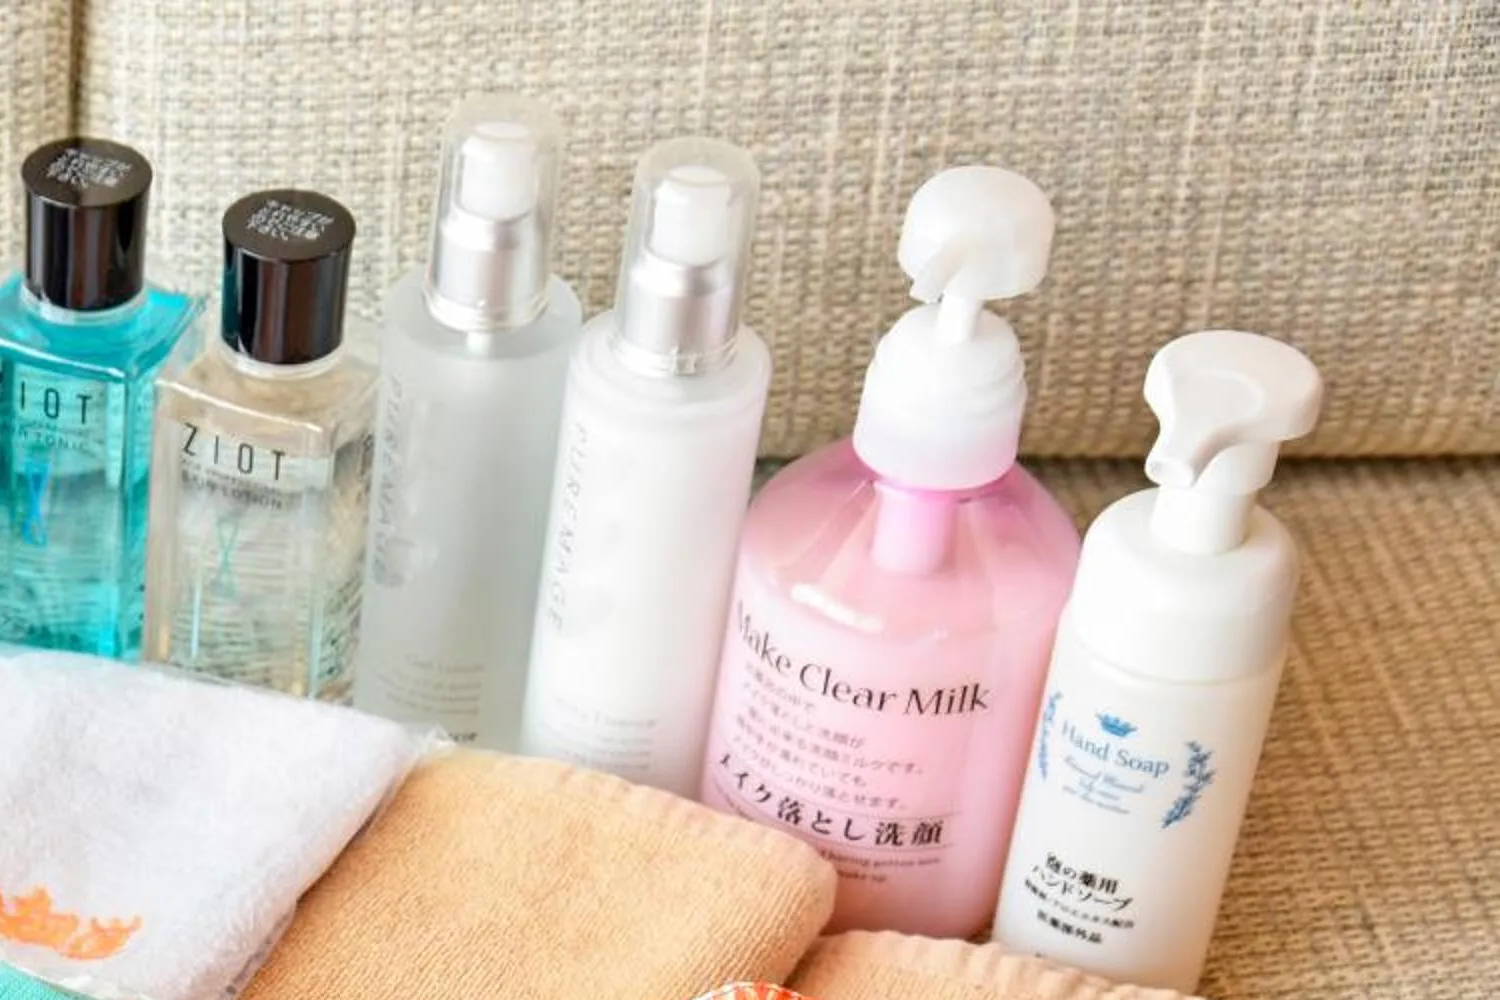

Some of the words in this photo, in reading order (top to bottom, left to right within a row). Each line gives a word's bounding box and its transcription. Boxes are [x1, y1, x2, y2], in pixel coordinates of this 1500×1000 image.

[182, 422, 286, 480] ZIOT
[799, 662, 897, 712] Clear
[902, 682, 991, 717] Milk
[1061, 719, 1111, 762] Hand
[1115, 748, 1170, 779] Soap
